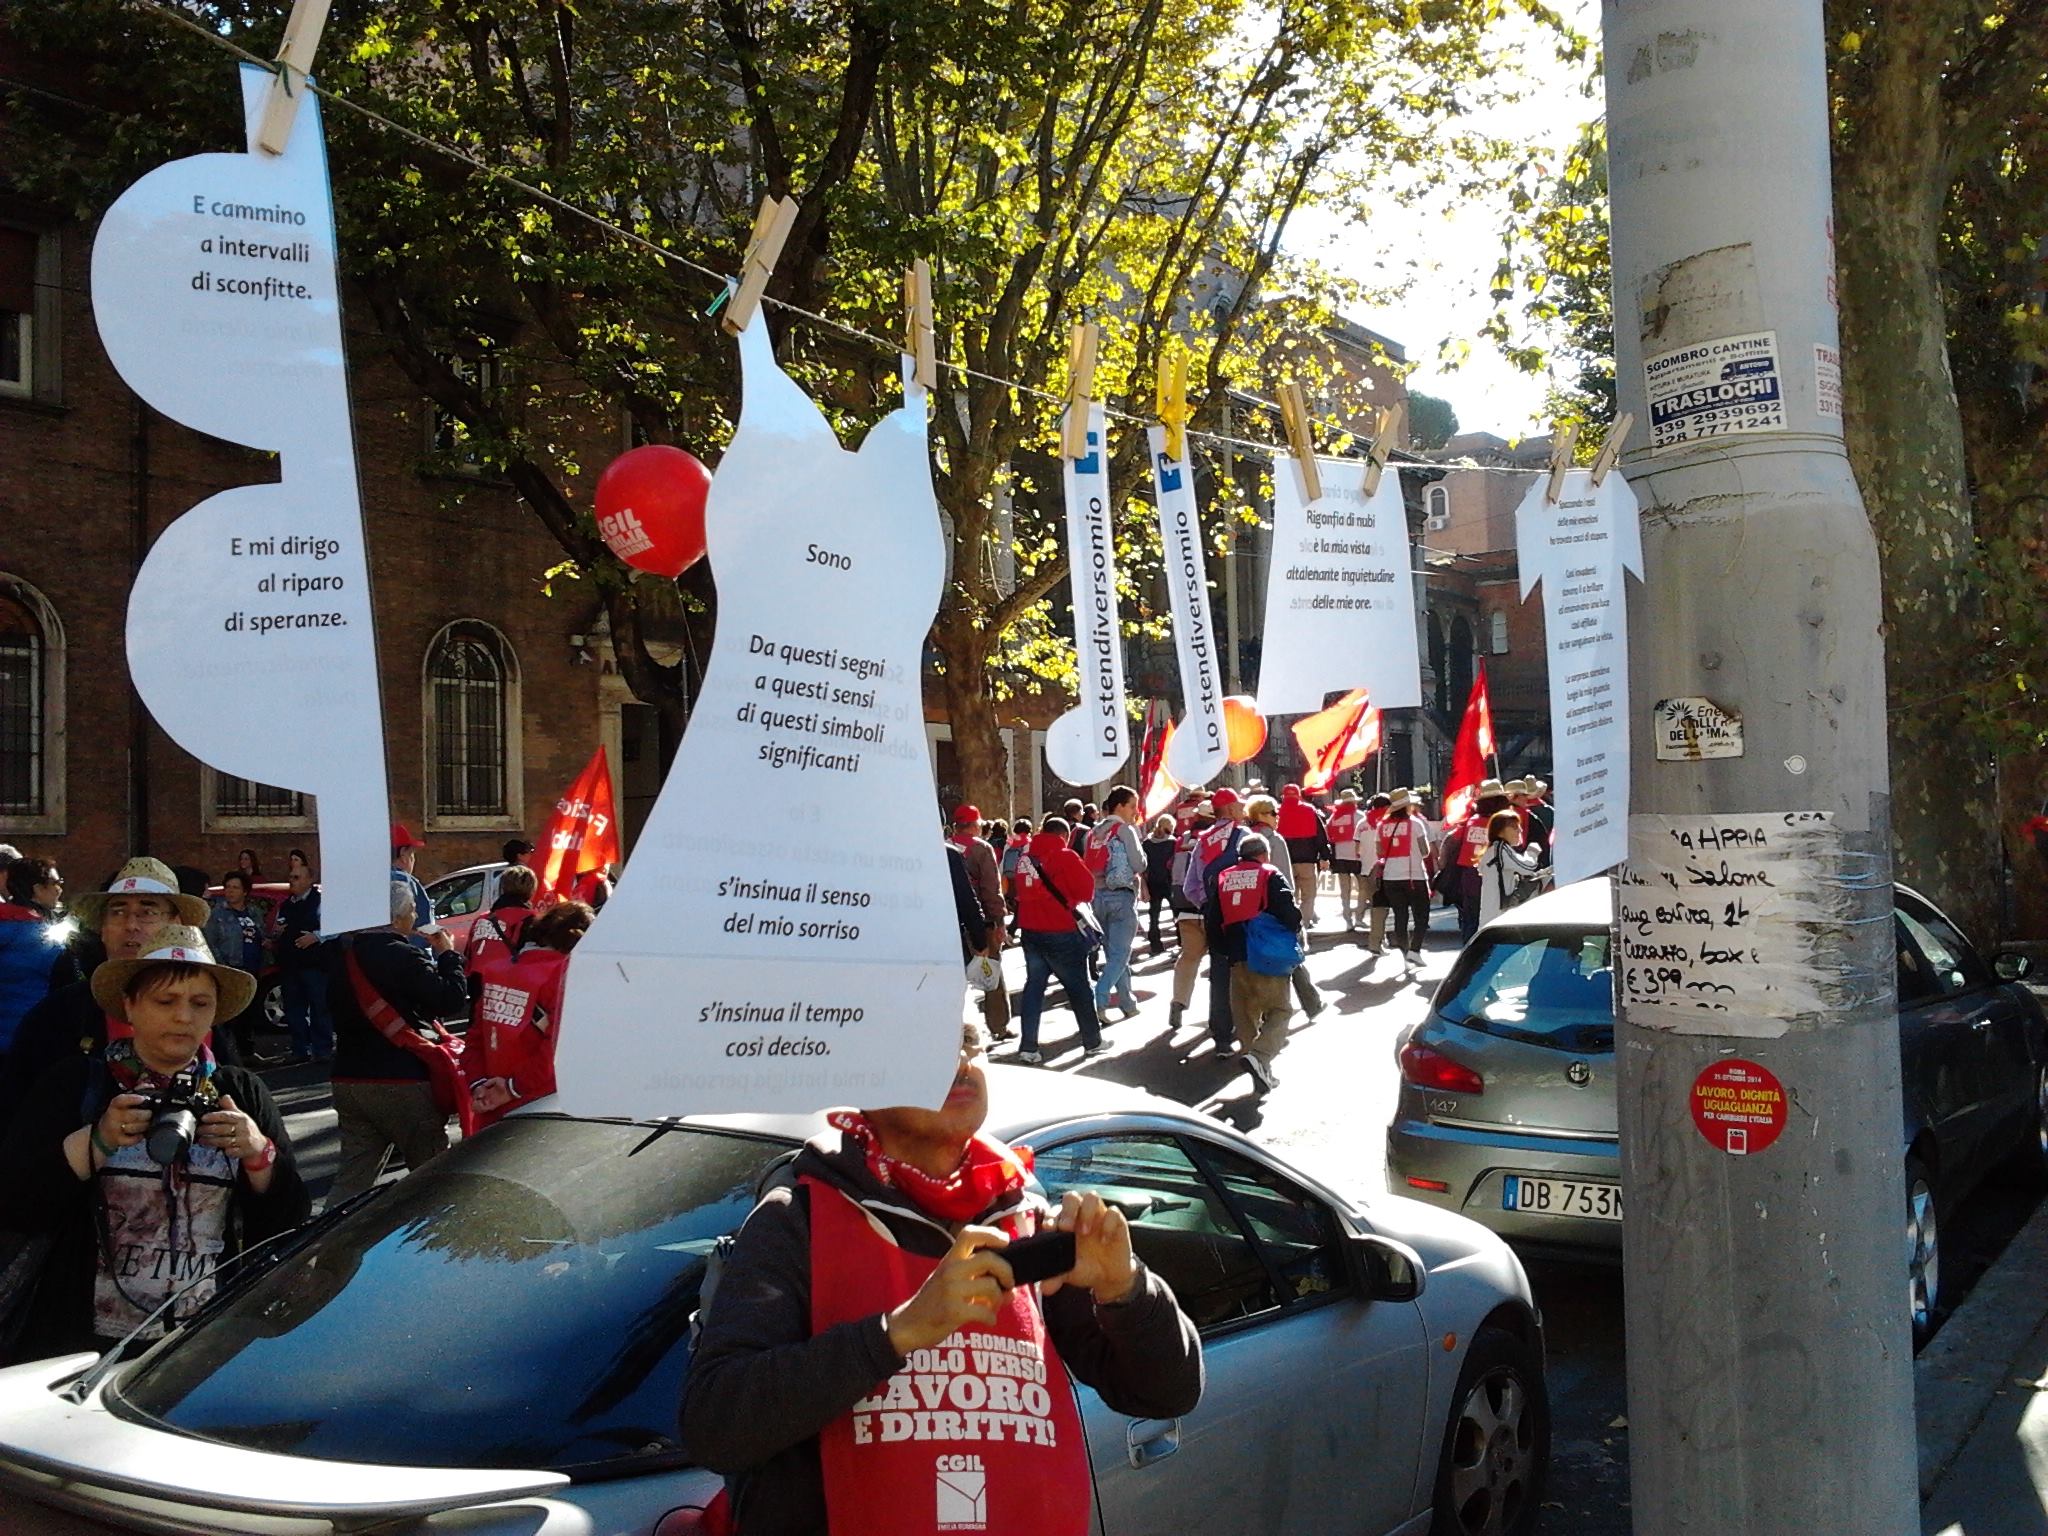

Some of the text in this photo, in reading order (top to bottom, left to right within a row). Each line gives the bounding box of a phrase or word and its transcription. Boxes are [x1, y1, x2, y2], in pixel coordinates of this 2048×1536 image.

[193, 195, 306, 226] E cammino
[200, 236, 310, 263] a intervalli
[191, 271, 312, 301] di sconfitte.
[1646, 338, 1771, 375] SGOMBRO CANTINE
[1655, 378, 1772, 416] TRASLOCHI
[1654, 420, 1686, 437] 339
[1692, 401, 1782, 426] 2939692
[1694, 414, 1781, 438] 7771241
[1306, 509, 1376, 529] Rigonfia di nubi
[231, 536, 340, 561] E mi dirigo
[805, 543, 852, 571] Sono
[1320, 538, 1330, 553] la
[1331, 540, 1349, 555] mia
[1350, 539, 1371, 555] vista
[258, 573, 344, 597] al riparo
[1286, 565, 1395, 587] altalenante inquietudine
[1312, 594, 1372, 610] delle mie ore.
[225, 612, 348, 635] di speranze.
[1086, 497, 1118, 758] Lo stendiversomio
[1176, 511, 1221, 753] Lo stendiversomio
[749, 634, 886, 682] Da questi segni
[755, 675, 876, 709] a questi sensi
[737, 701, 756, 723] di
[760, 708, 818, 733] questi
[821, 717, 886, 743] simboli
[758, 740, 860, 773] significanti
[717, 876, 871, 908] s'insinua il senso
[724, 912, 860, 940] del mio sorriso
[699, 1002, 864, 1029] s'insinua il tempo
[725, 1035, 832, 1057] così deciso.
[1697, 1086, 1738, 1101] LAVORO,
[1703, 1099, 1773, 1115] UGUAGLIANZA
[1521, 1180, 1551, 1210] DB
[899, 1349, 1047, 1385] SOLO VERSO
[853, 1411, 1057, 1448] E DIRITTI!
[935, 1455, 985, 1471] CGIL
